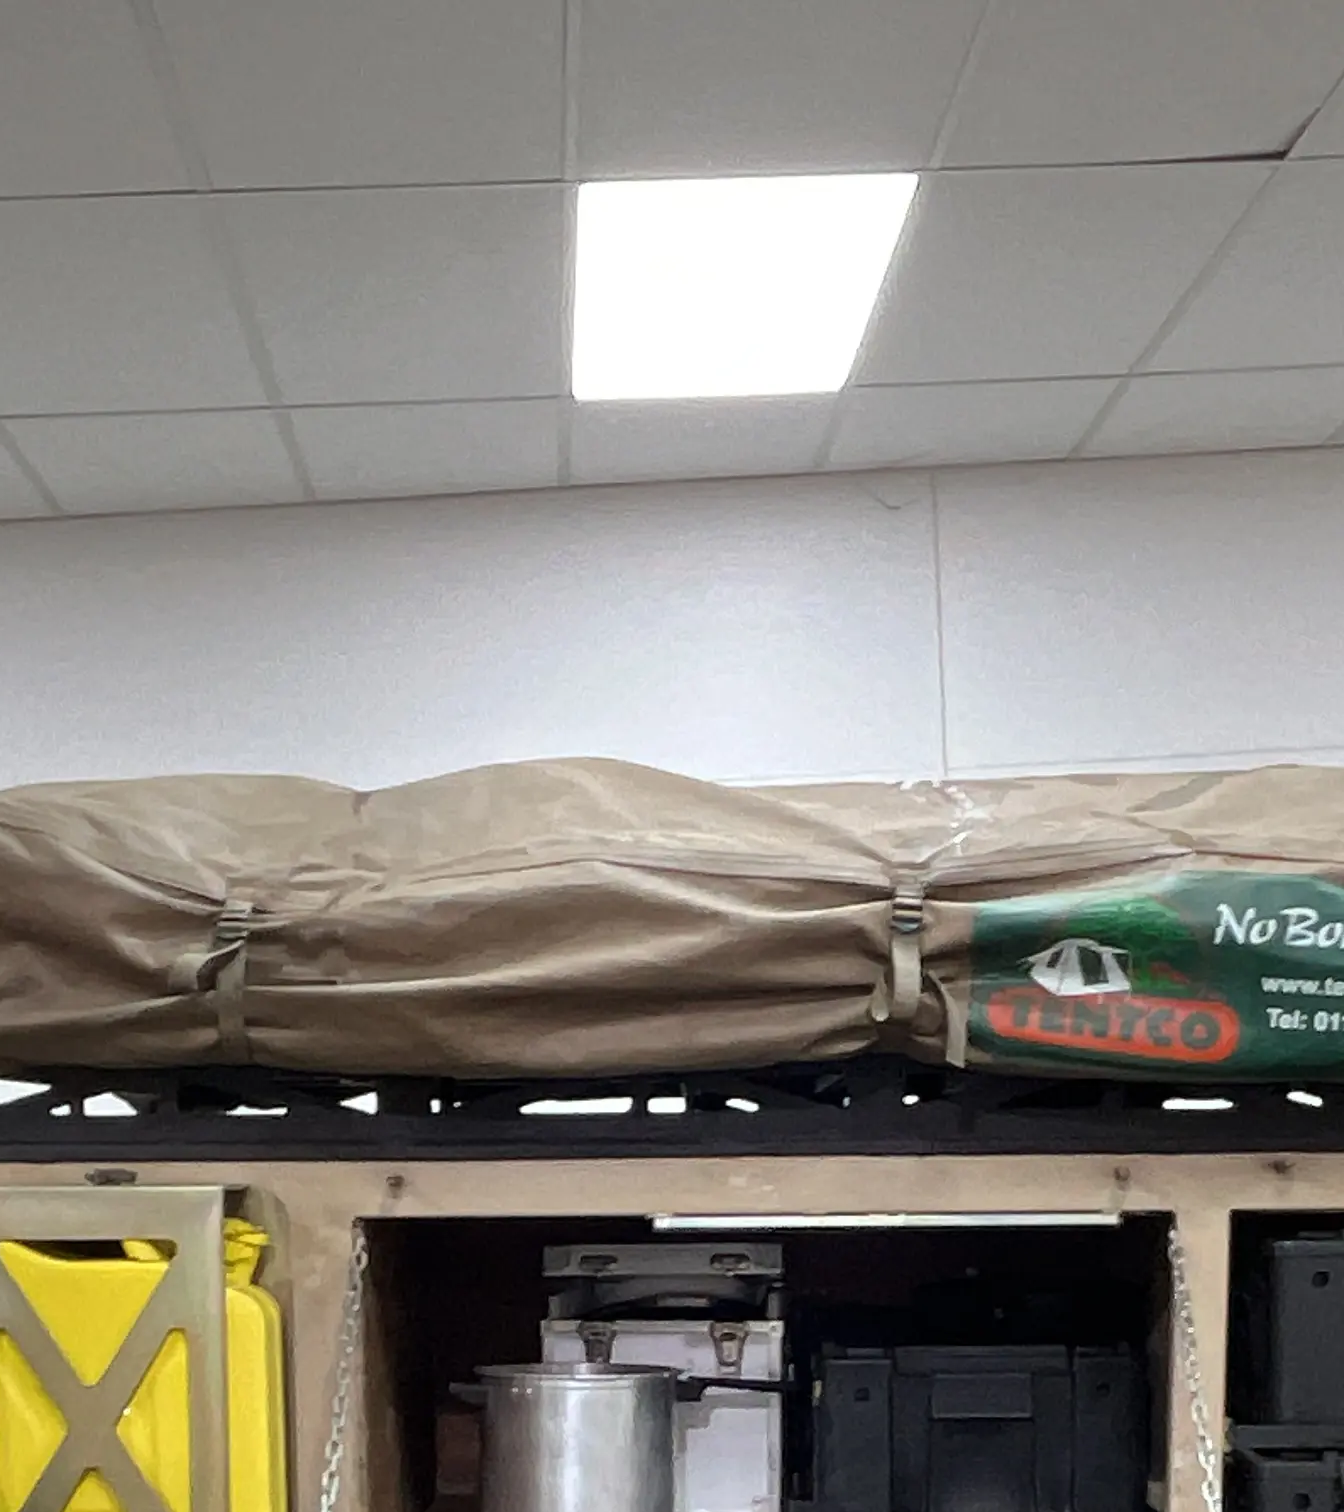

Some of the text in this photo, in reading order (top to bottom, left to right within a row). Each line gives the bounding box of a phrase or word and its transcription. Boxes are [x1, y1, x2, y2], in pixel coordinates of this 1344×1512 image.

[1213, 903, 1277, 945] No
[1009, 994, 1220, 1050] TENTCO
[1266, 1007, 1308, 1030] Tel:
